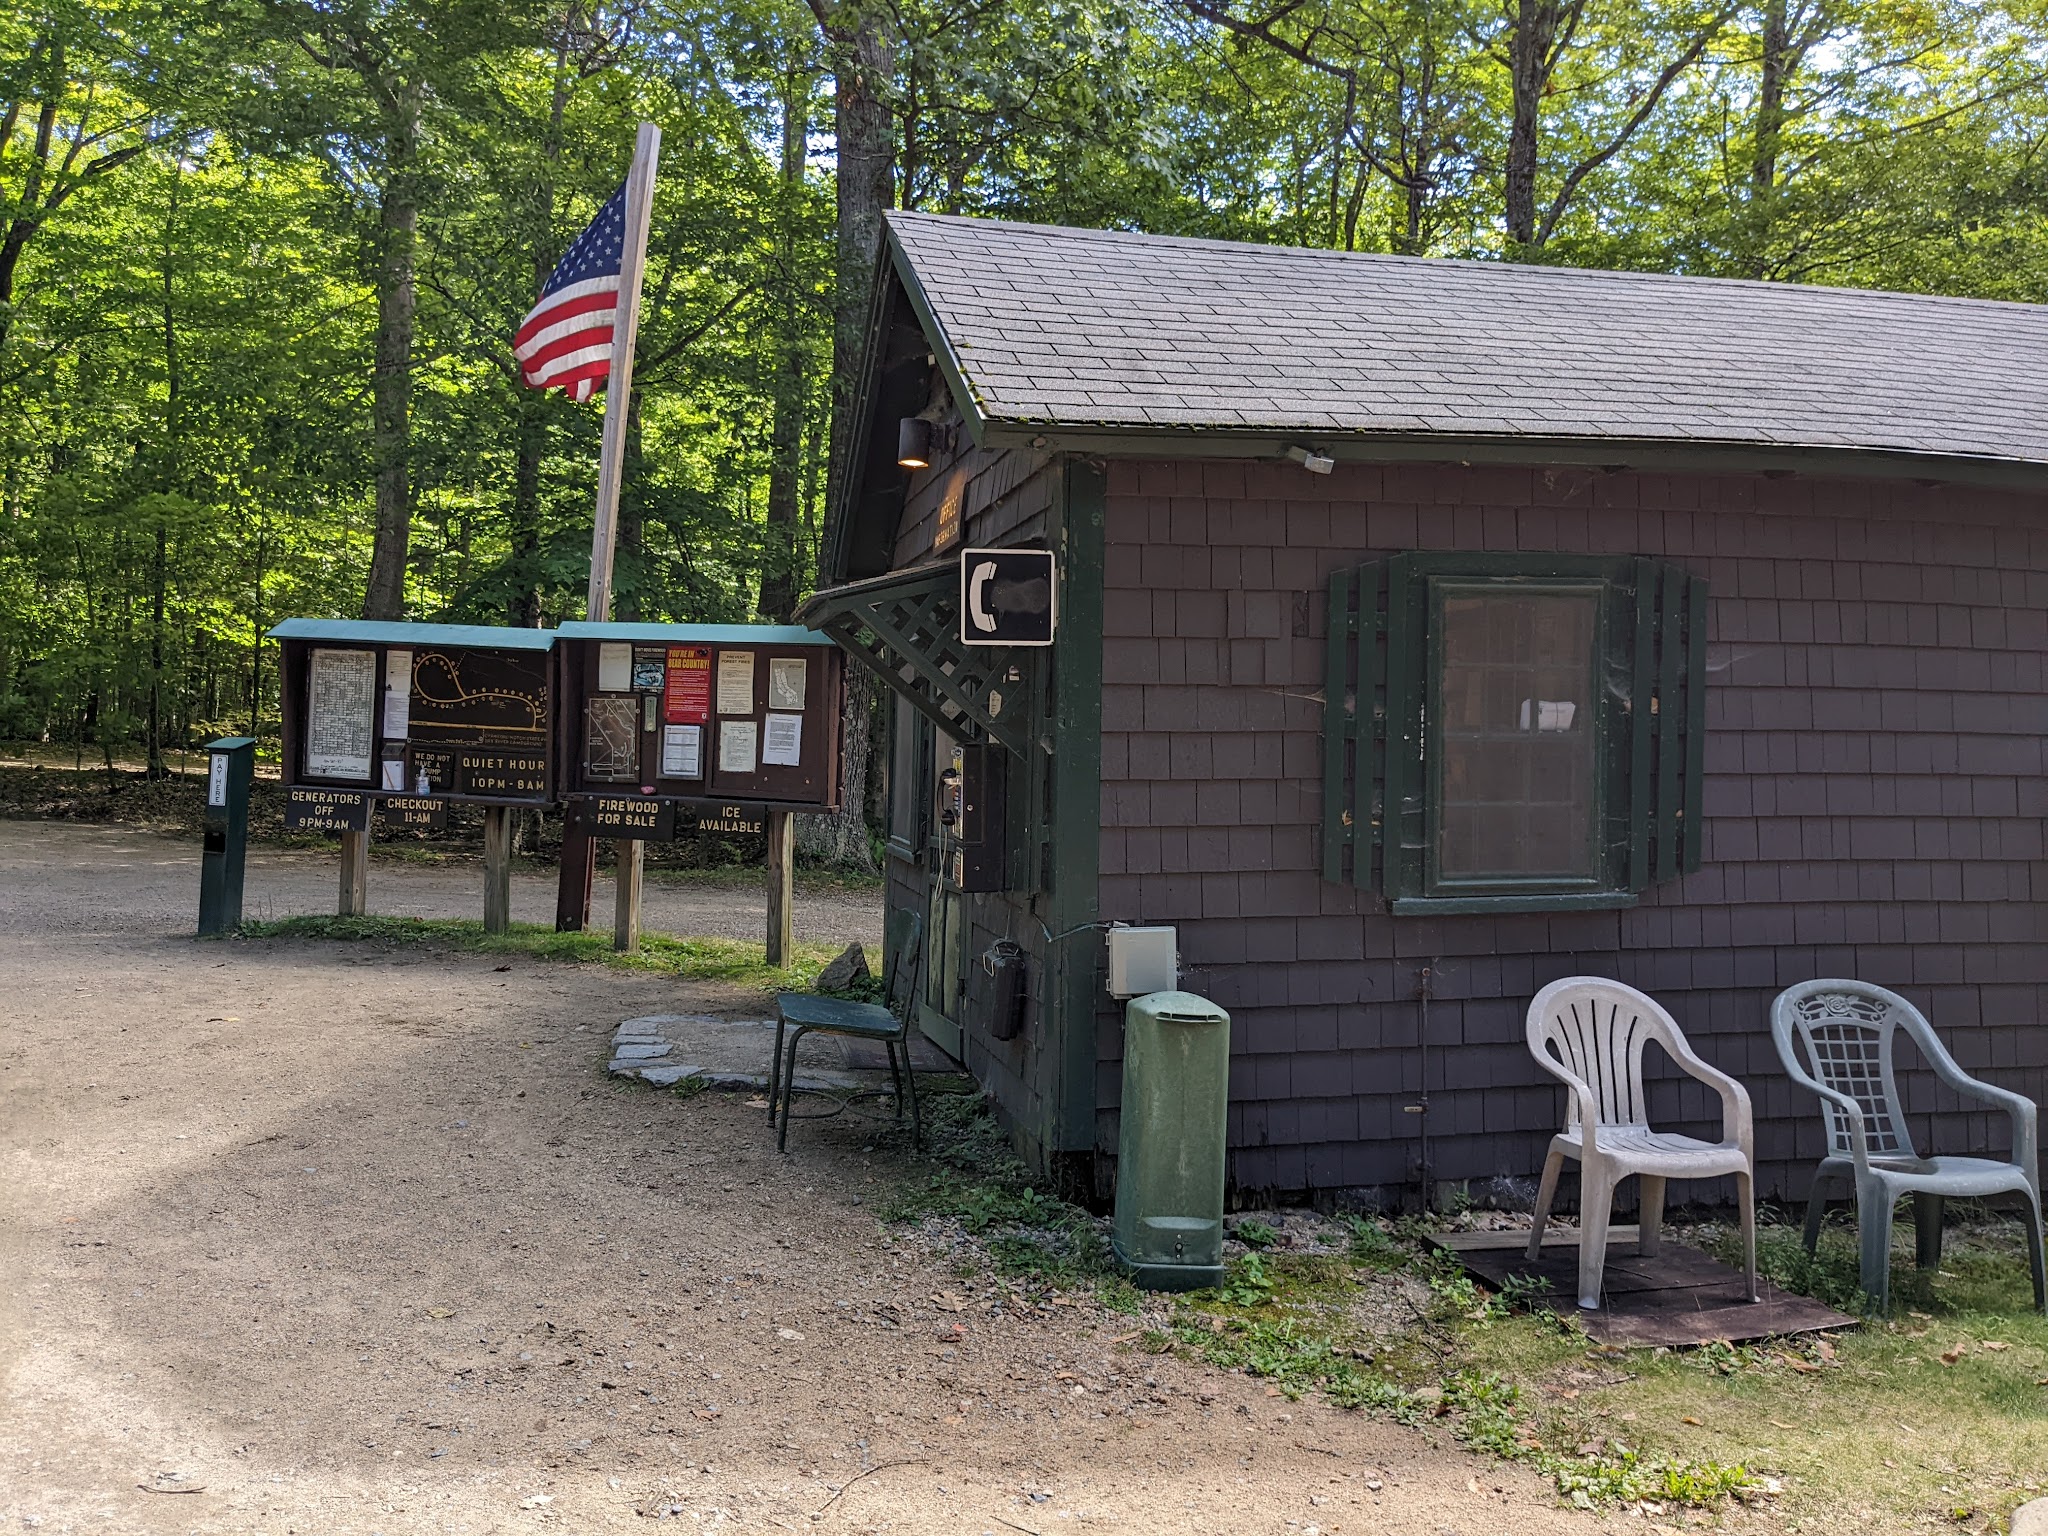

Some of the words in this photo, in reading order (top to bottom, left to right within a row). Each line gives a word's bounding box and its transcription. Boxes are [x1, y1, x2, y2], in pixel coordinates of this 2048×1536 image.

[940, 495, 958, 525] OFFICE
[669, 649, 687, 658] YOU'RE
[687, 650, 695, 658] IN
[668, 658, 681, 668] BEAR
[682, 659, 710, 669] COUNTRY!
[415, 752, 425, 760] WE
[426, 753, 435, 761] DO
[414, 759, 432, 768] HAVE
[462, 757, 504, 769] QUIET
[424, 767, 442, 776] DUMP
[291, 791, 361, 805] GENERATORS
[314, 805, 335, 816] OFF
[387, 798, 443, 811] CHECKOUT
[599, 799, 659, 814] FIREWOOD
[404, 812, 431, 824] 11-AM
[722, 806, 741, 818] ICE
[597, 813, 621, 825] FOR
[625, 815, 656, 827] SALE
[699, 819, 762, 834] AVAILABLE
